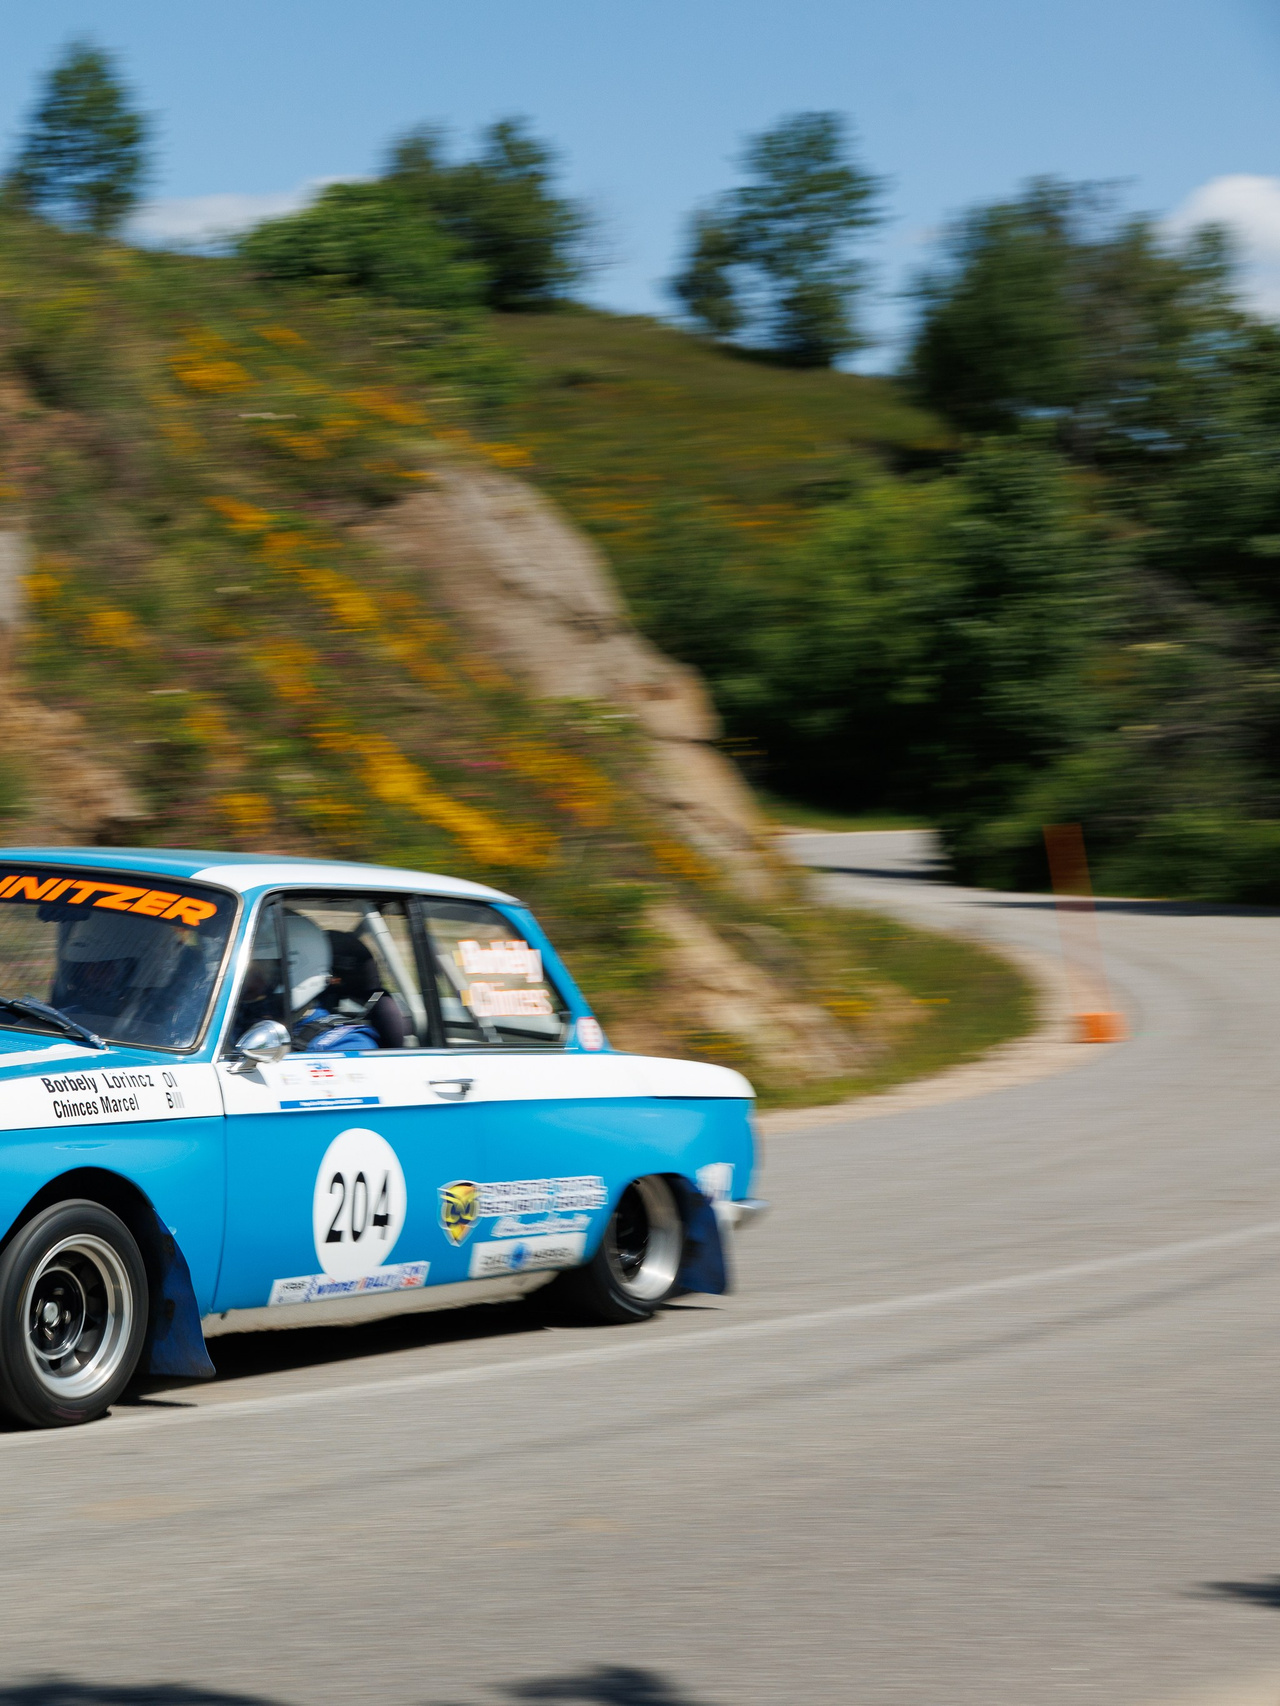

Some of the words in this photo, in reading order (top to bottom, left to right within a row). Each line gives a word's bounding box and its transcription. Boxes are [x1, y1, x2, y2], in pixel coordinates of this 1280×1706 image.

[52, 1097, 99, 1119] Chinces
[99, 1093, 140, 1114] Marcel
[324, 1169, 392, 1244] 204
